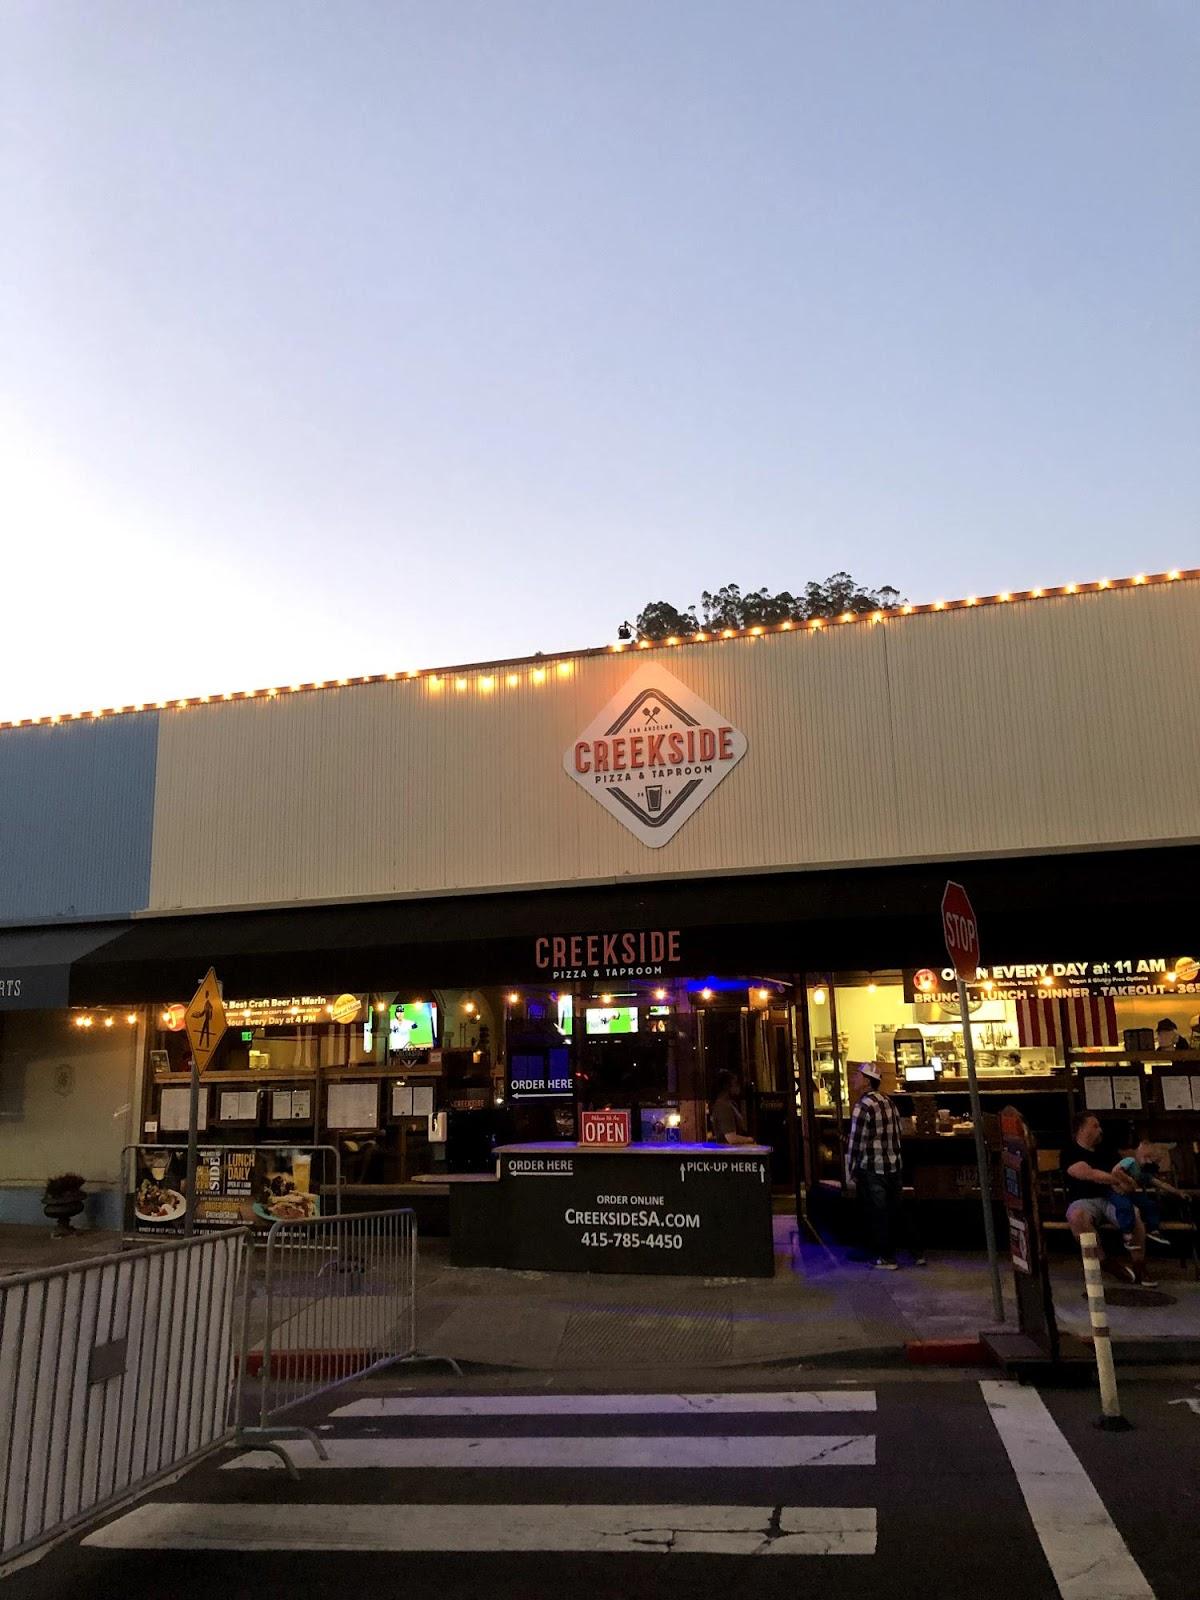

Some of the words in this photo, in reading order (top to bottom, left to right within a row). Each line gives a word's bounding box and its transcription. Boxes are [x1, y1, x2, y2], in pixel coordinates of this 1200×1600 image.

[575, 727, 734, 773] CREEKSIDE
[595, 773, 632, 784] PIZZA
[638, 772, 645, 780] &
[652, 765, 713, 779] TAPROOM
[945, 911, 976, 953] STOP
[535, 930, 681, 968] CREEKSIDE
[553, 969, 587, 979] PIZZA
[593, 969, 600, 977] &
[606, 966, 662, 977] TAPROOM
[941, 967, 988, 981] ON
[993, 964, 1049, 979] EVERY
[1053, 962, 1088, 977] DAY
[1093, 962, 1110, 975] at
[1114, 960, 1132, 974] 11
[1136, 959, 1166, 973] AM
[981, 989, 1027, 1001] LUNCH
[1038, 987, 1090, 1000] DINNER
[1100, 985, 1166, 997] TAKEOUT
[229, 1000, 248, 1009] Best
[249, 999, 270, 1008] Craft
[271, 998, 290, 1007] Beer
[291, 996, 300, 1006] in
[301, 996, 326, 1005] Marin
[245, 1018, 267, 1027] Every
[268, 1017, 285, 1026] Day
[286, 1016, 294, 1024] at
[295, 1015, 301, 1023] 4
[302, 1015, 317, 1023] PM
[511, 1079, 545, 1090] ORDER
[547, 1079, 573, 1089] HERE
[585, 1122, 625, 1142] OPEN
[227, 1153, 256, 1168] LUNCH
[508, 1160, 544, 1170] ORDER
[547, 1160, 573, 1170] HERE
[687, 1161, 728, 1172] PICK-UP
[731, 1161, 758, 1172] HERE
[227, 1167, 250, 1181] DAILY
[597, 1194, 629, 1205] ORDER
[630, 1195, 665, 1206] ONLINE
[581, 1232, 683, 1249] 415-785-4450
